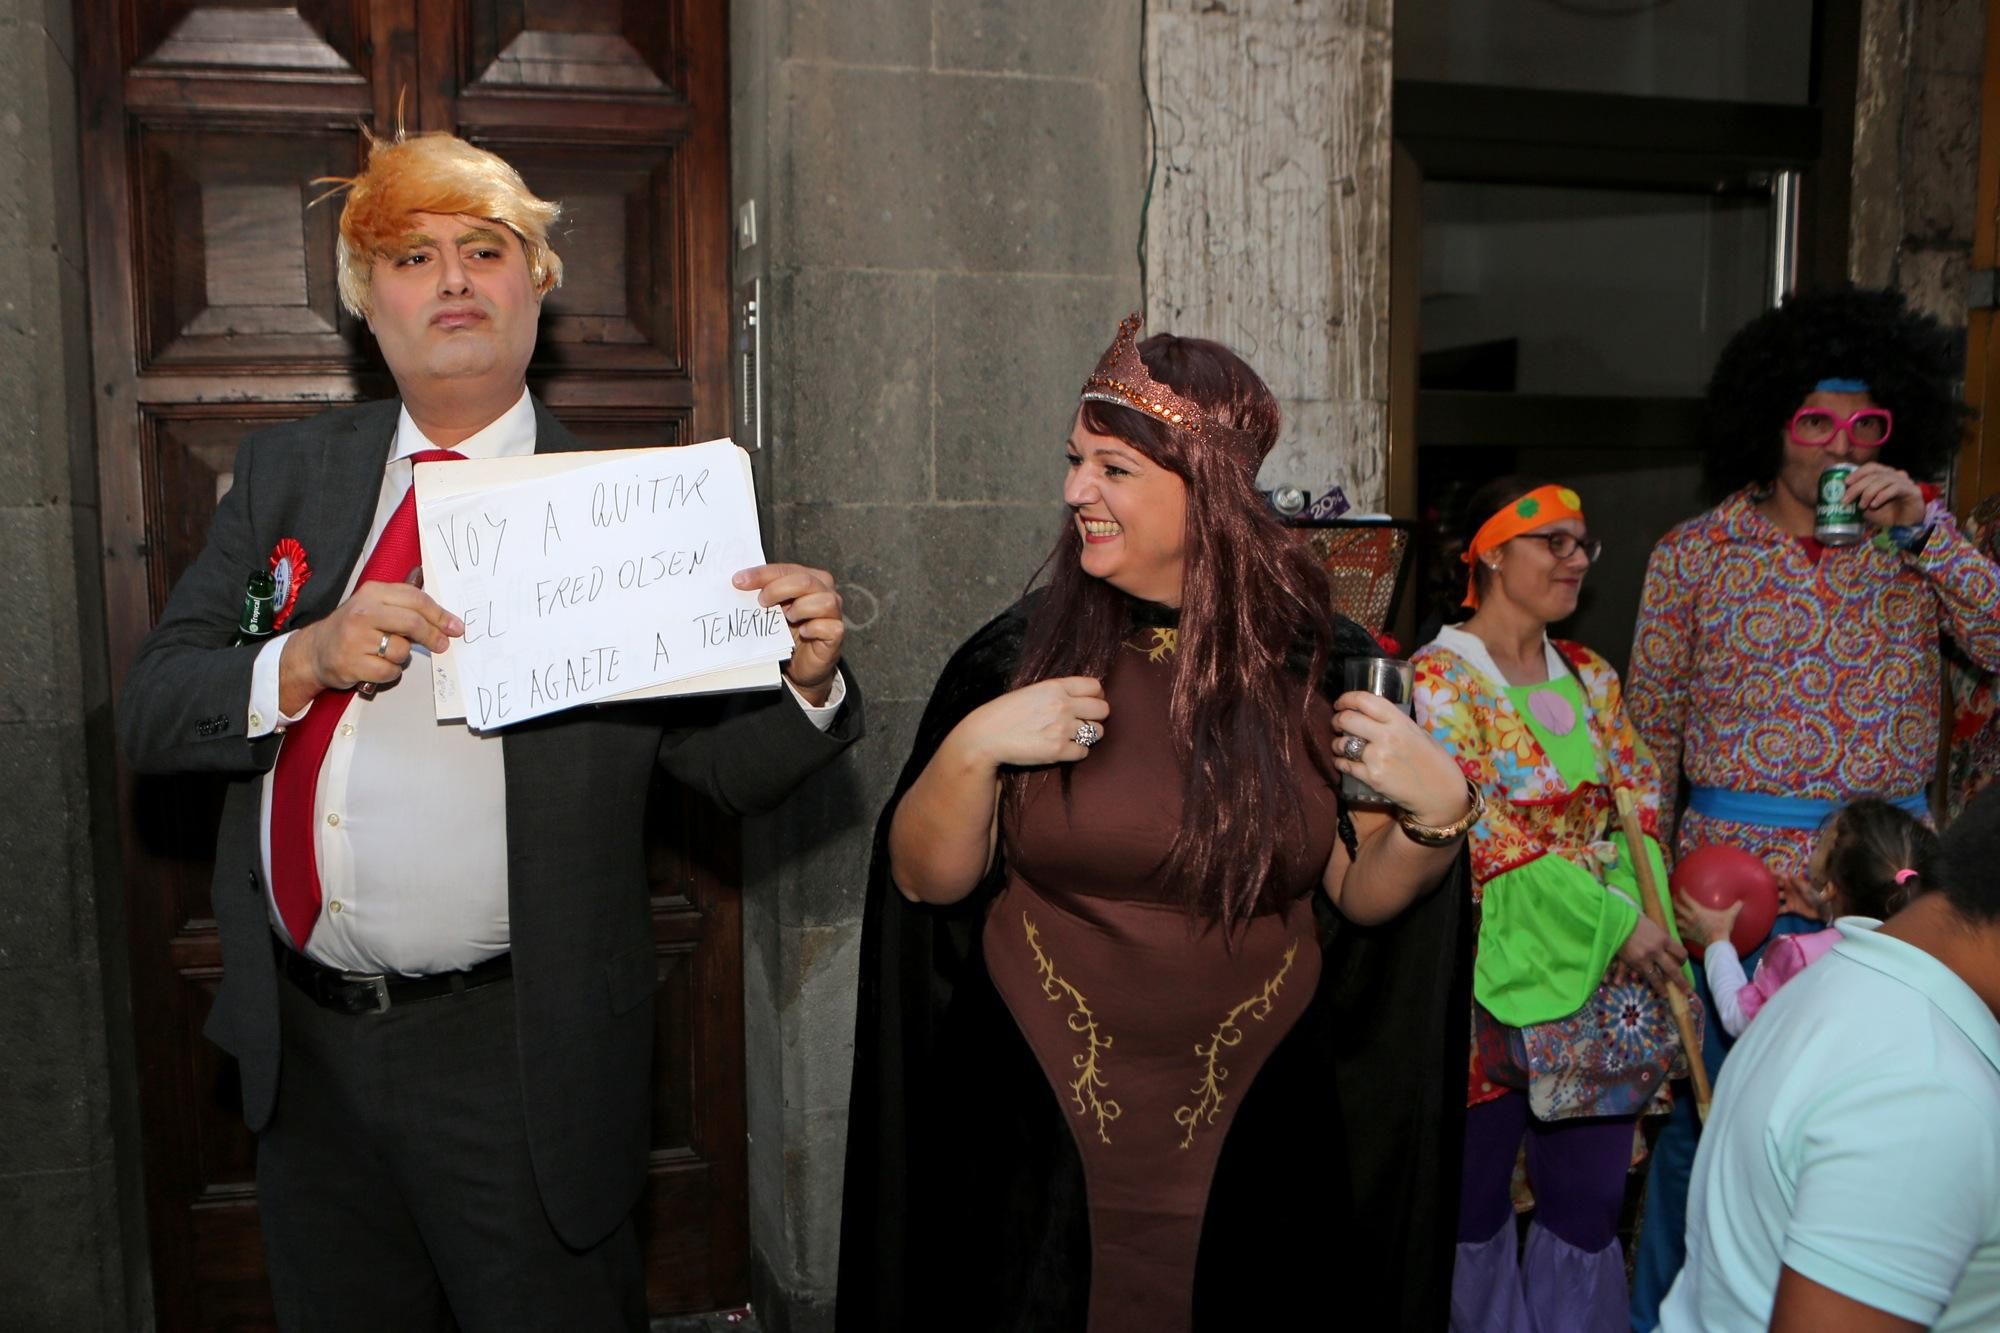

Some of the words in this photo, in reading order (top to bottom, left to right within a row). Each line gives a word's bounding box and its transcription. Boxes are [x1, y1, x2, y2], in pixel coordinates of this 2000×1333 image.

[437, 512, 508, 576] VOY
[543, 500, 562, 556] A
[1816, 503, 1856, 517] ropical
[250, 599, 260, 623] Tropical
[462, 601, 506, 645] EL
[536, 566, 604, 618] FRED
[618, 540, 710, 590] OLSEN
[477, 680, 510, 726] DE
[530, 645, 621, 709] AGAETE
[653, 631, 670, 672] A
